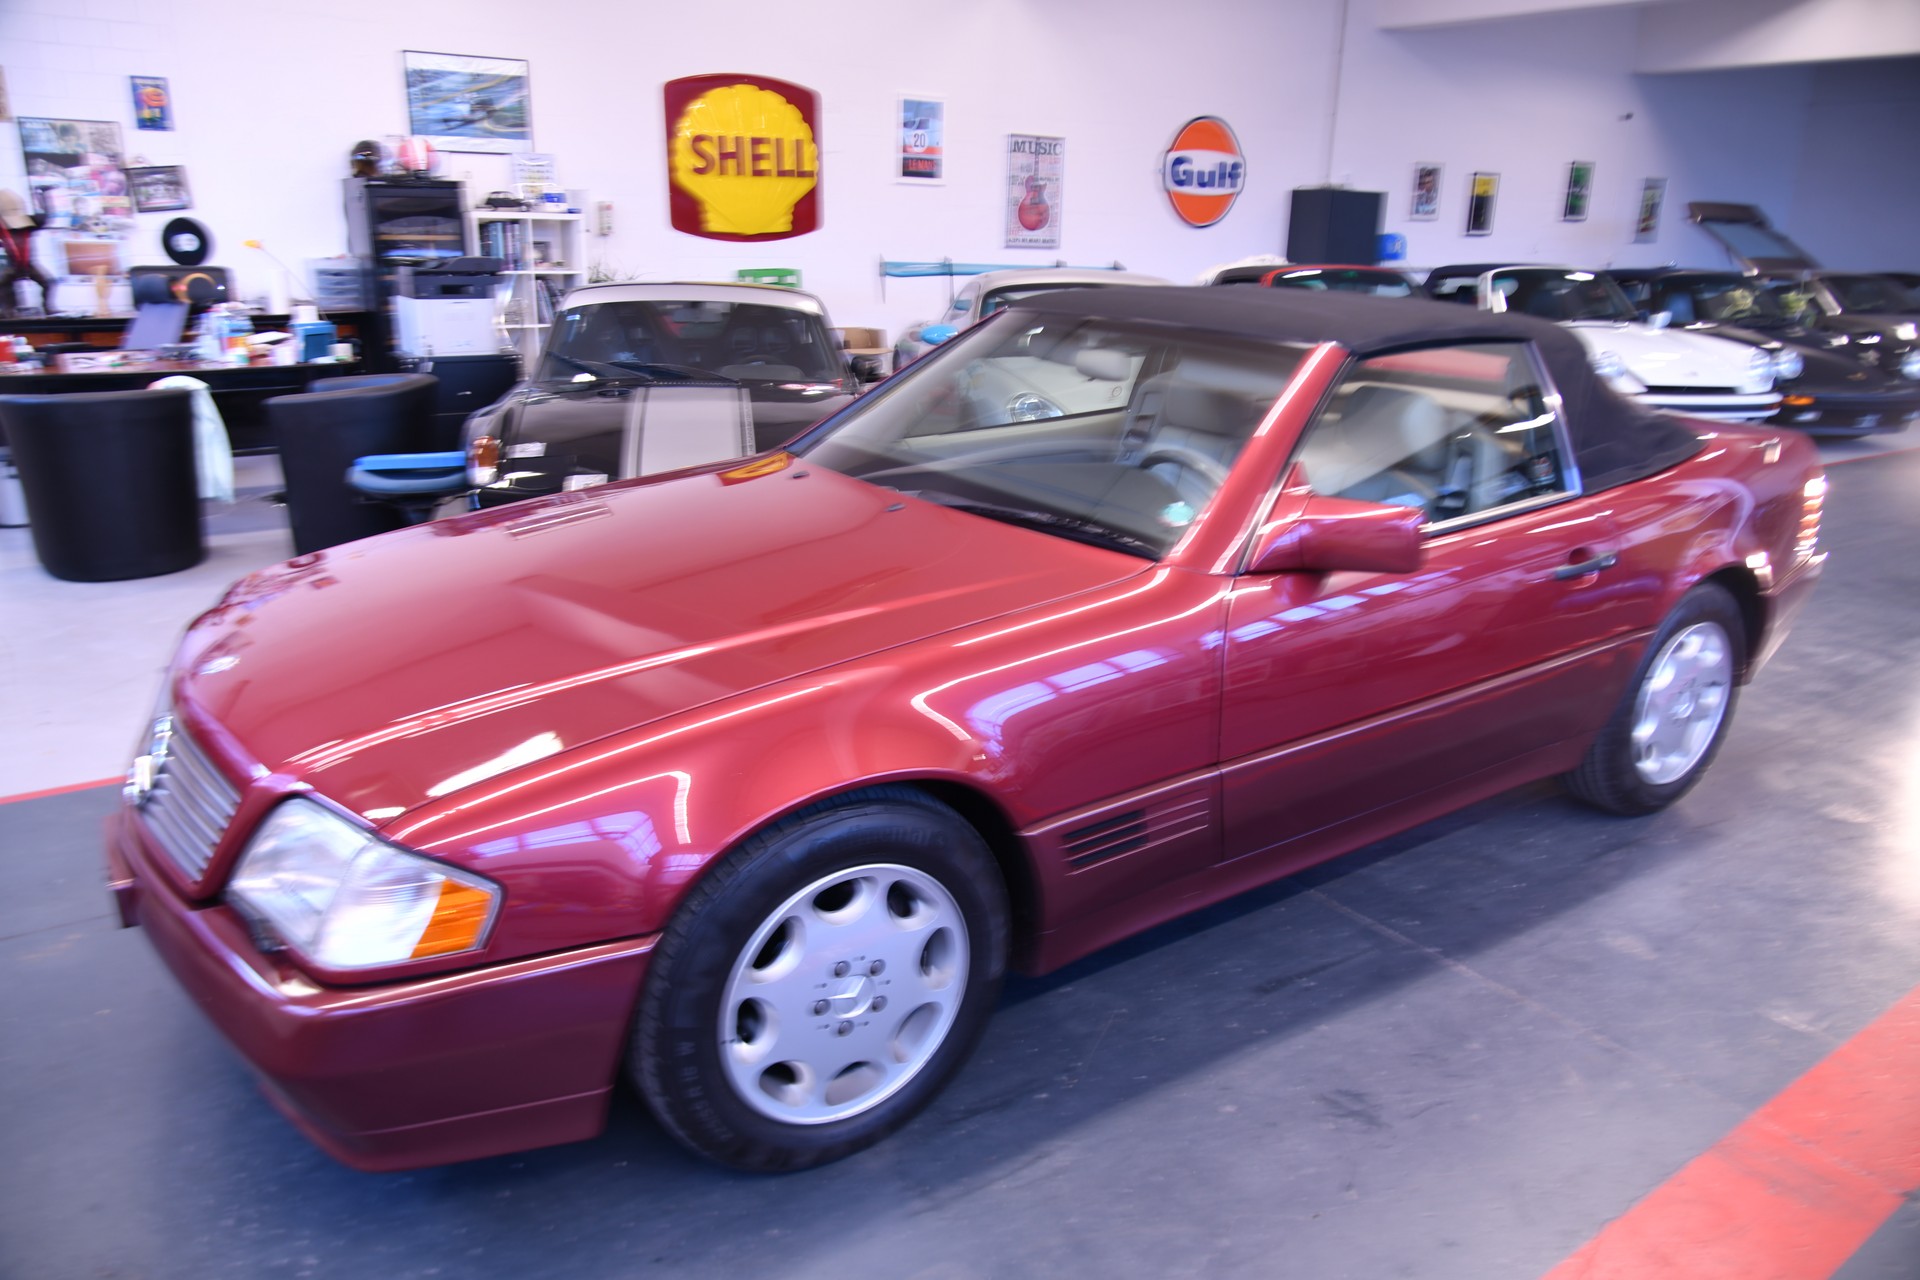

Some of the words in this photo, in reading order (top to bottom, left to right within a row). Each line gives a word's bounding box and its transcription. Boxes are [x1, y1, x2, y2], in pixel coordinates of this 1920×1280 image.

[913, 132, 926, 148] 20
[1012, 139, 1063, 156] MUSIC
[691, 134, 815, 178] SHELL
[1171, 156, 1243, 189] Gulf
[675, 1041, 697, 1057] W
